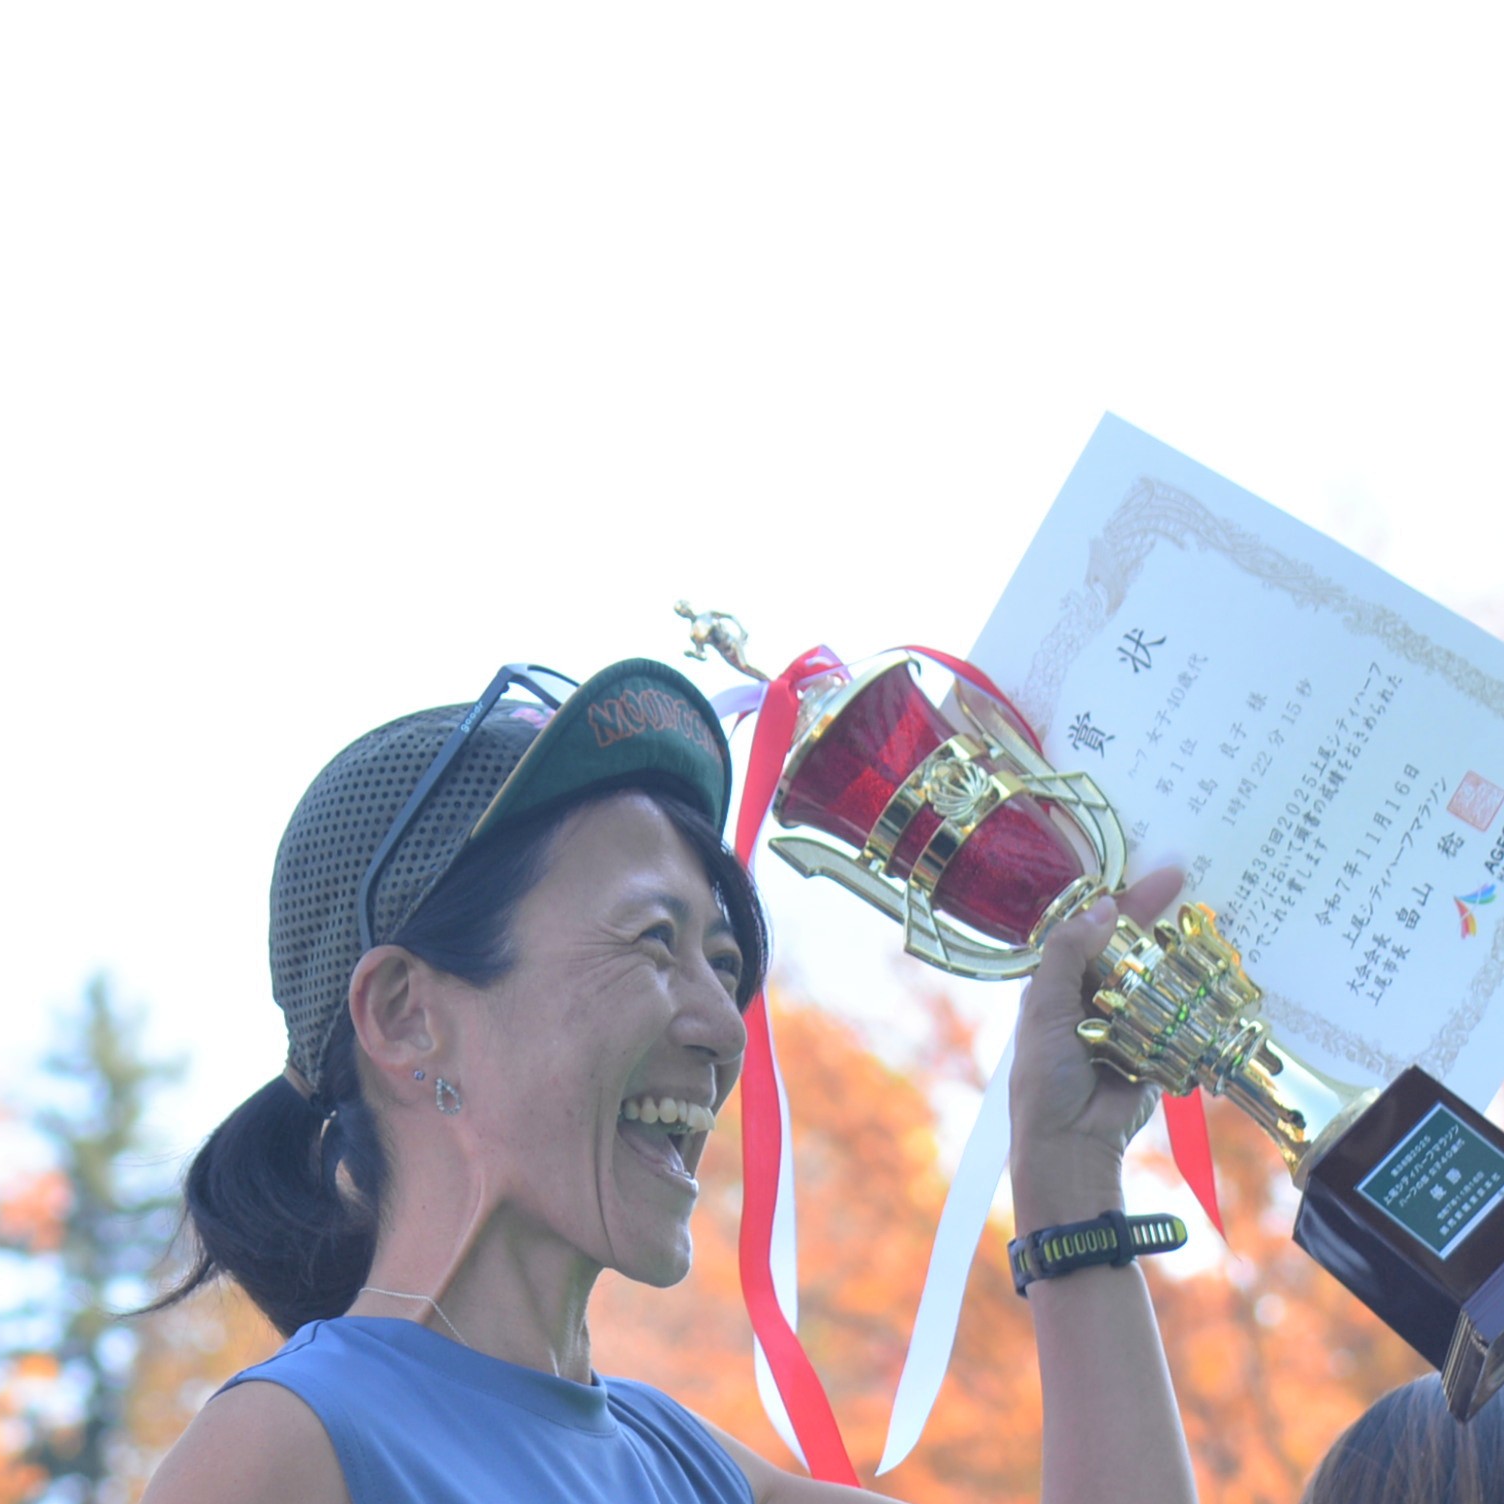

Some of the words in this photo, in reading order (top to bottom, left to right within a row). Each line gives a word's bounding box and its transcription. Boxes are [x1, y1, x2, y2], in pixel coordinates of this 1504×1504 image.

[460, 700, 483, 733] goodr
[1067, 628, 1167, 758] 賞状
[1314, 763, 1419, 925] 令和7年11月16日
[1341, 777, 1446, 949] 上尾シティハーフマラソン
[1345, 933, 1391, 996] 大会会長
